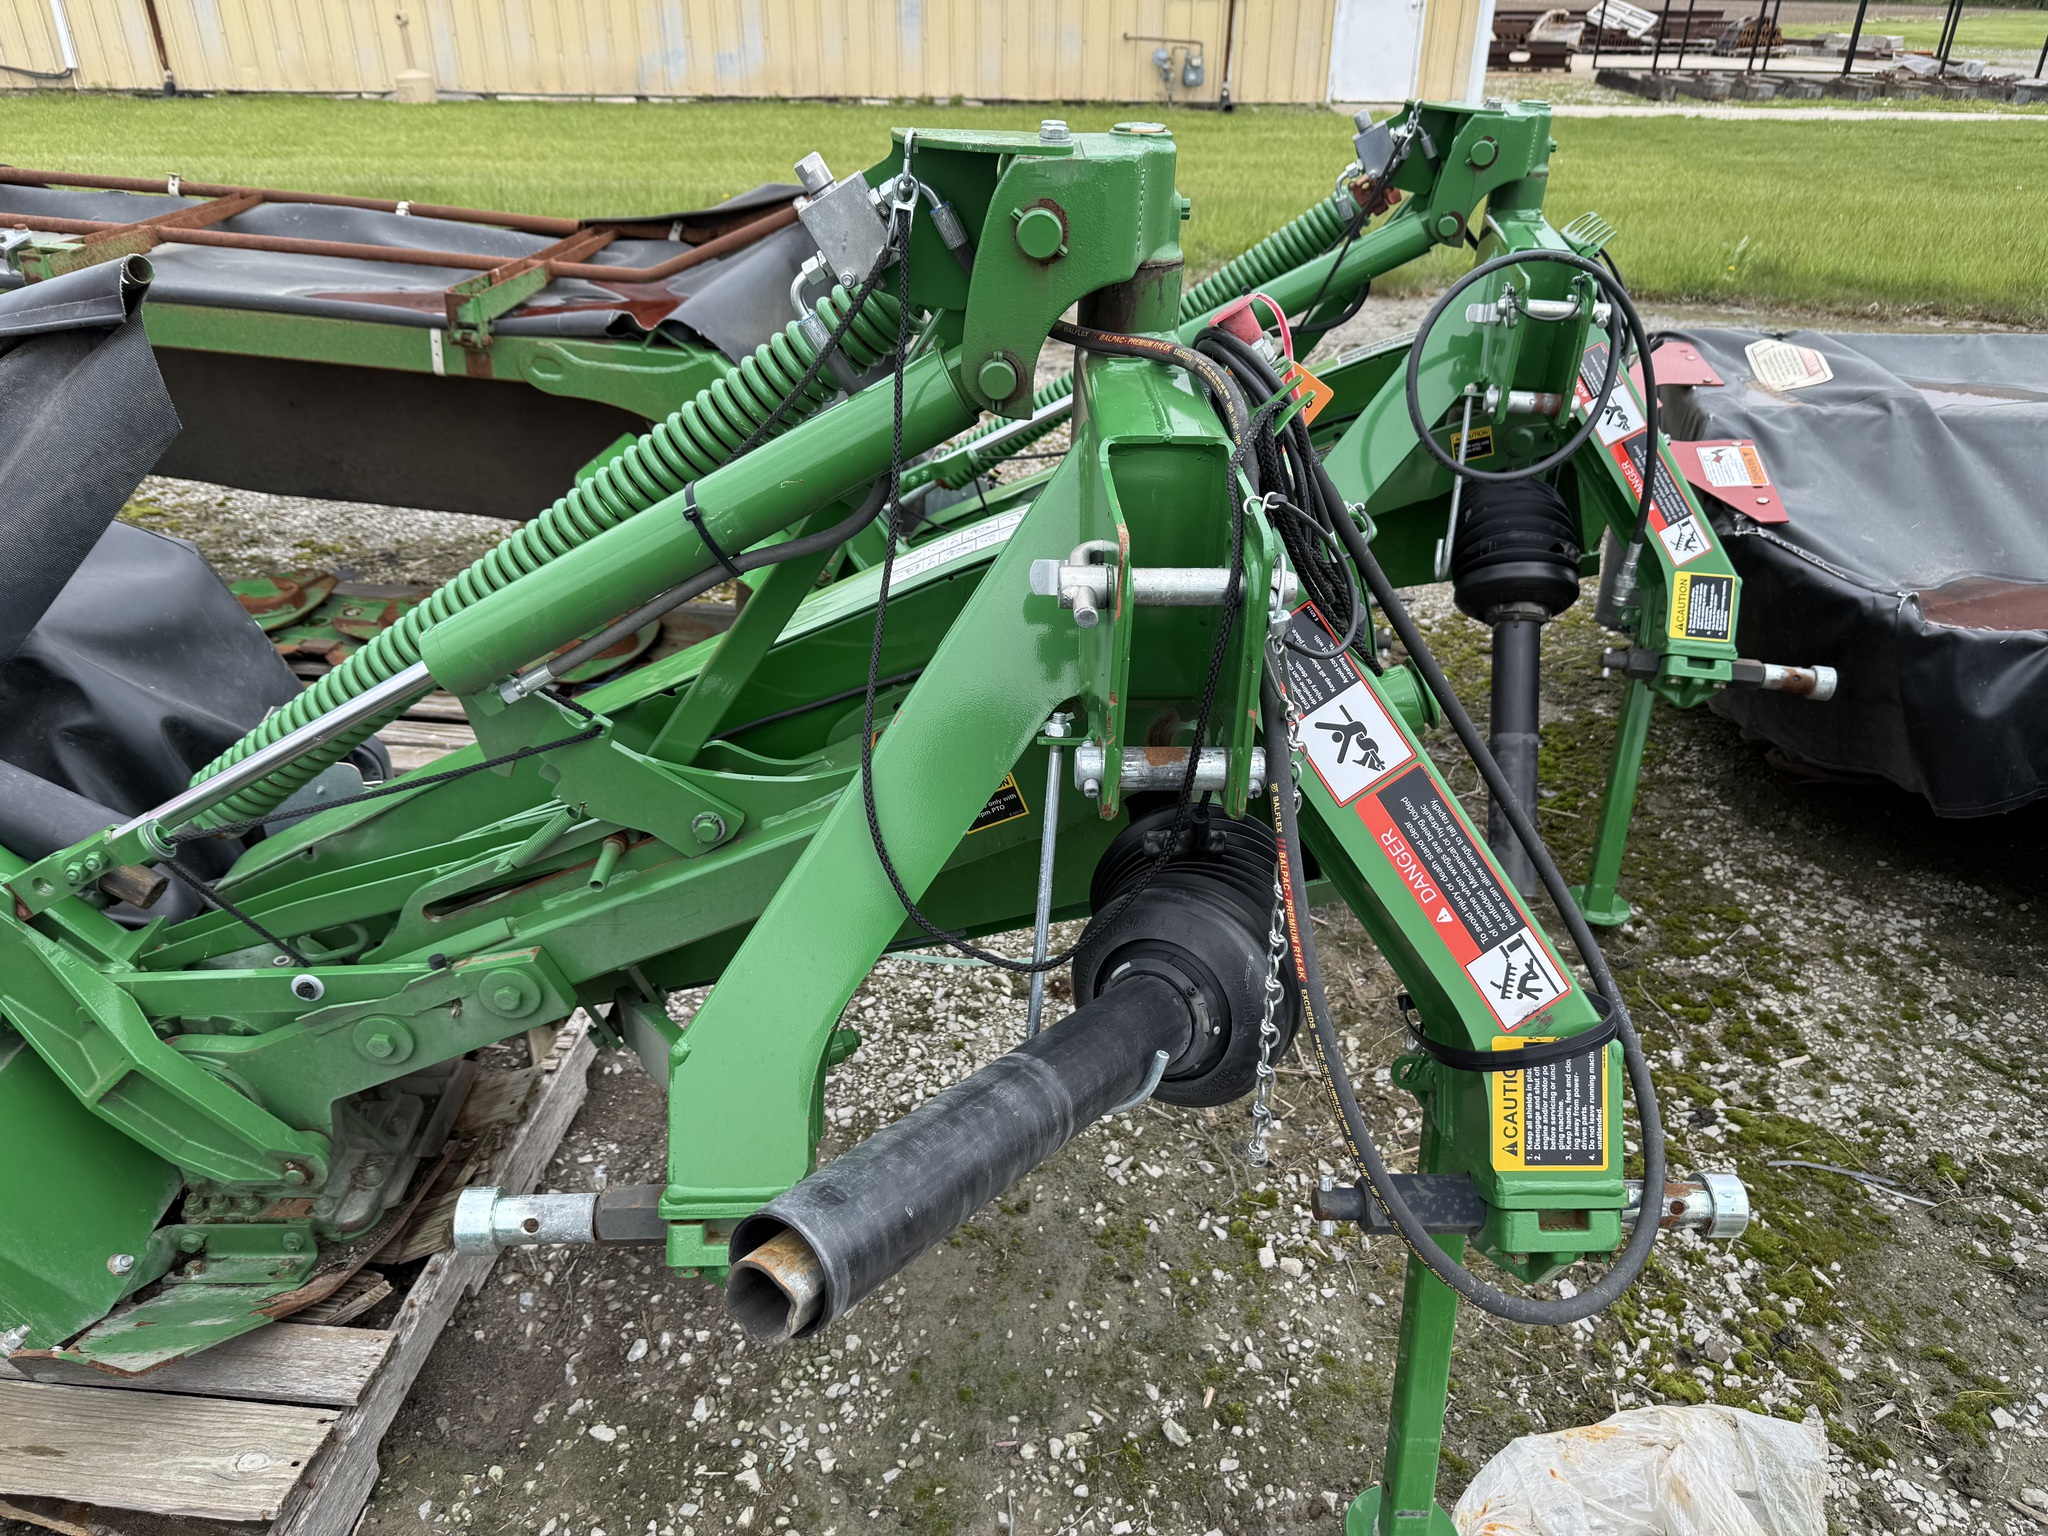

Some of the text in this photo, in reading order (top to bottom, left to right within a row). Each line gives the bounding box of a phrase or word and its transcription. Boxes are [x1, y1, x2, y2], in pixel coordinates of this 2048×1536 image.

[1063, 324, 1090, 337] BALFLEX
[1099, 333, 1124, 343] BALPAC
[1127, 337, 1154, 348] PREMIUM
[1172, 348, 1192, 362] EXCEEDS
[1676, 579, 1688, 622] CAUTION
[1291, 627, 1305, 645] place.
[1314, 634, 1324, 647] with
[1292, 670, 1301, 681] can
[1295, 660, 1308, 677] death.
[1335, 667, 1349, 683] Avoid
[1338, 657, 1355, 679] rotating
[1299, 681, 1317, 705] driveline
[1310, 684, 1323, 701] injury
[1324, 677, 1336, 692] Keep
[988, 798, 1002, 807] only
[991, 805, 1005, 813] PTO
[1420, 804, 1445, 838] hydraulic
[1442, 837, 1450, 846] or
[1380, 828, 1437, 903] DANGER
[1400, 796, 1498, 936] of machine when wings are being folded
[1430, 797, 1517, 925] failure can allow wings to fall rapidly.
[1447, 846, 1479, 888] Mechanical
[1404, 821, 1488, 944] To avoid injury or death stand clear
[1476, 887, 1501, 922] unfolded.
[1498, 922, 1507, 930] or
[1272, 796, 1282, 833] BALFLEX
[1278, 853, 1291, 891] BALPAC
[1285, 899, 1299, 945] PREMIUM
[1301, 989, 1316, 1029] EXCEEDS
[1369, 1185, 1379, 1200] WP
[1525, 1068, 1533, 1082] plac
[1550, 1082, 1556, 1090] or
[1588, 1074, 1596, 1103] running
[1502, 1069, 1518, 1139] CAUTIO
[1549, 1091, 1558, 1125] servicing
[1526, 1130, 1534, 1150] Keep
[1534, 1111, 1542, 1150] Disengage
[1542, 1125, 1550, 1150] engine
[1565, 1130, 1573, 1150] Keep
[1557, 1133, 1565, 1150] ging
[1573, 1138, 1581, 1150] ing
[1588, 1139, 1595, 1149] Do
